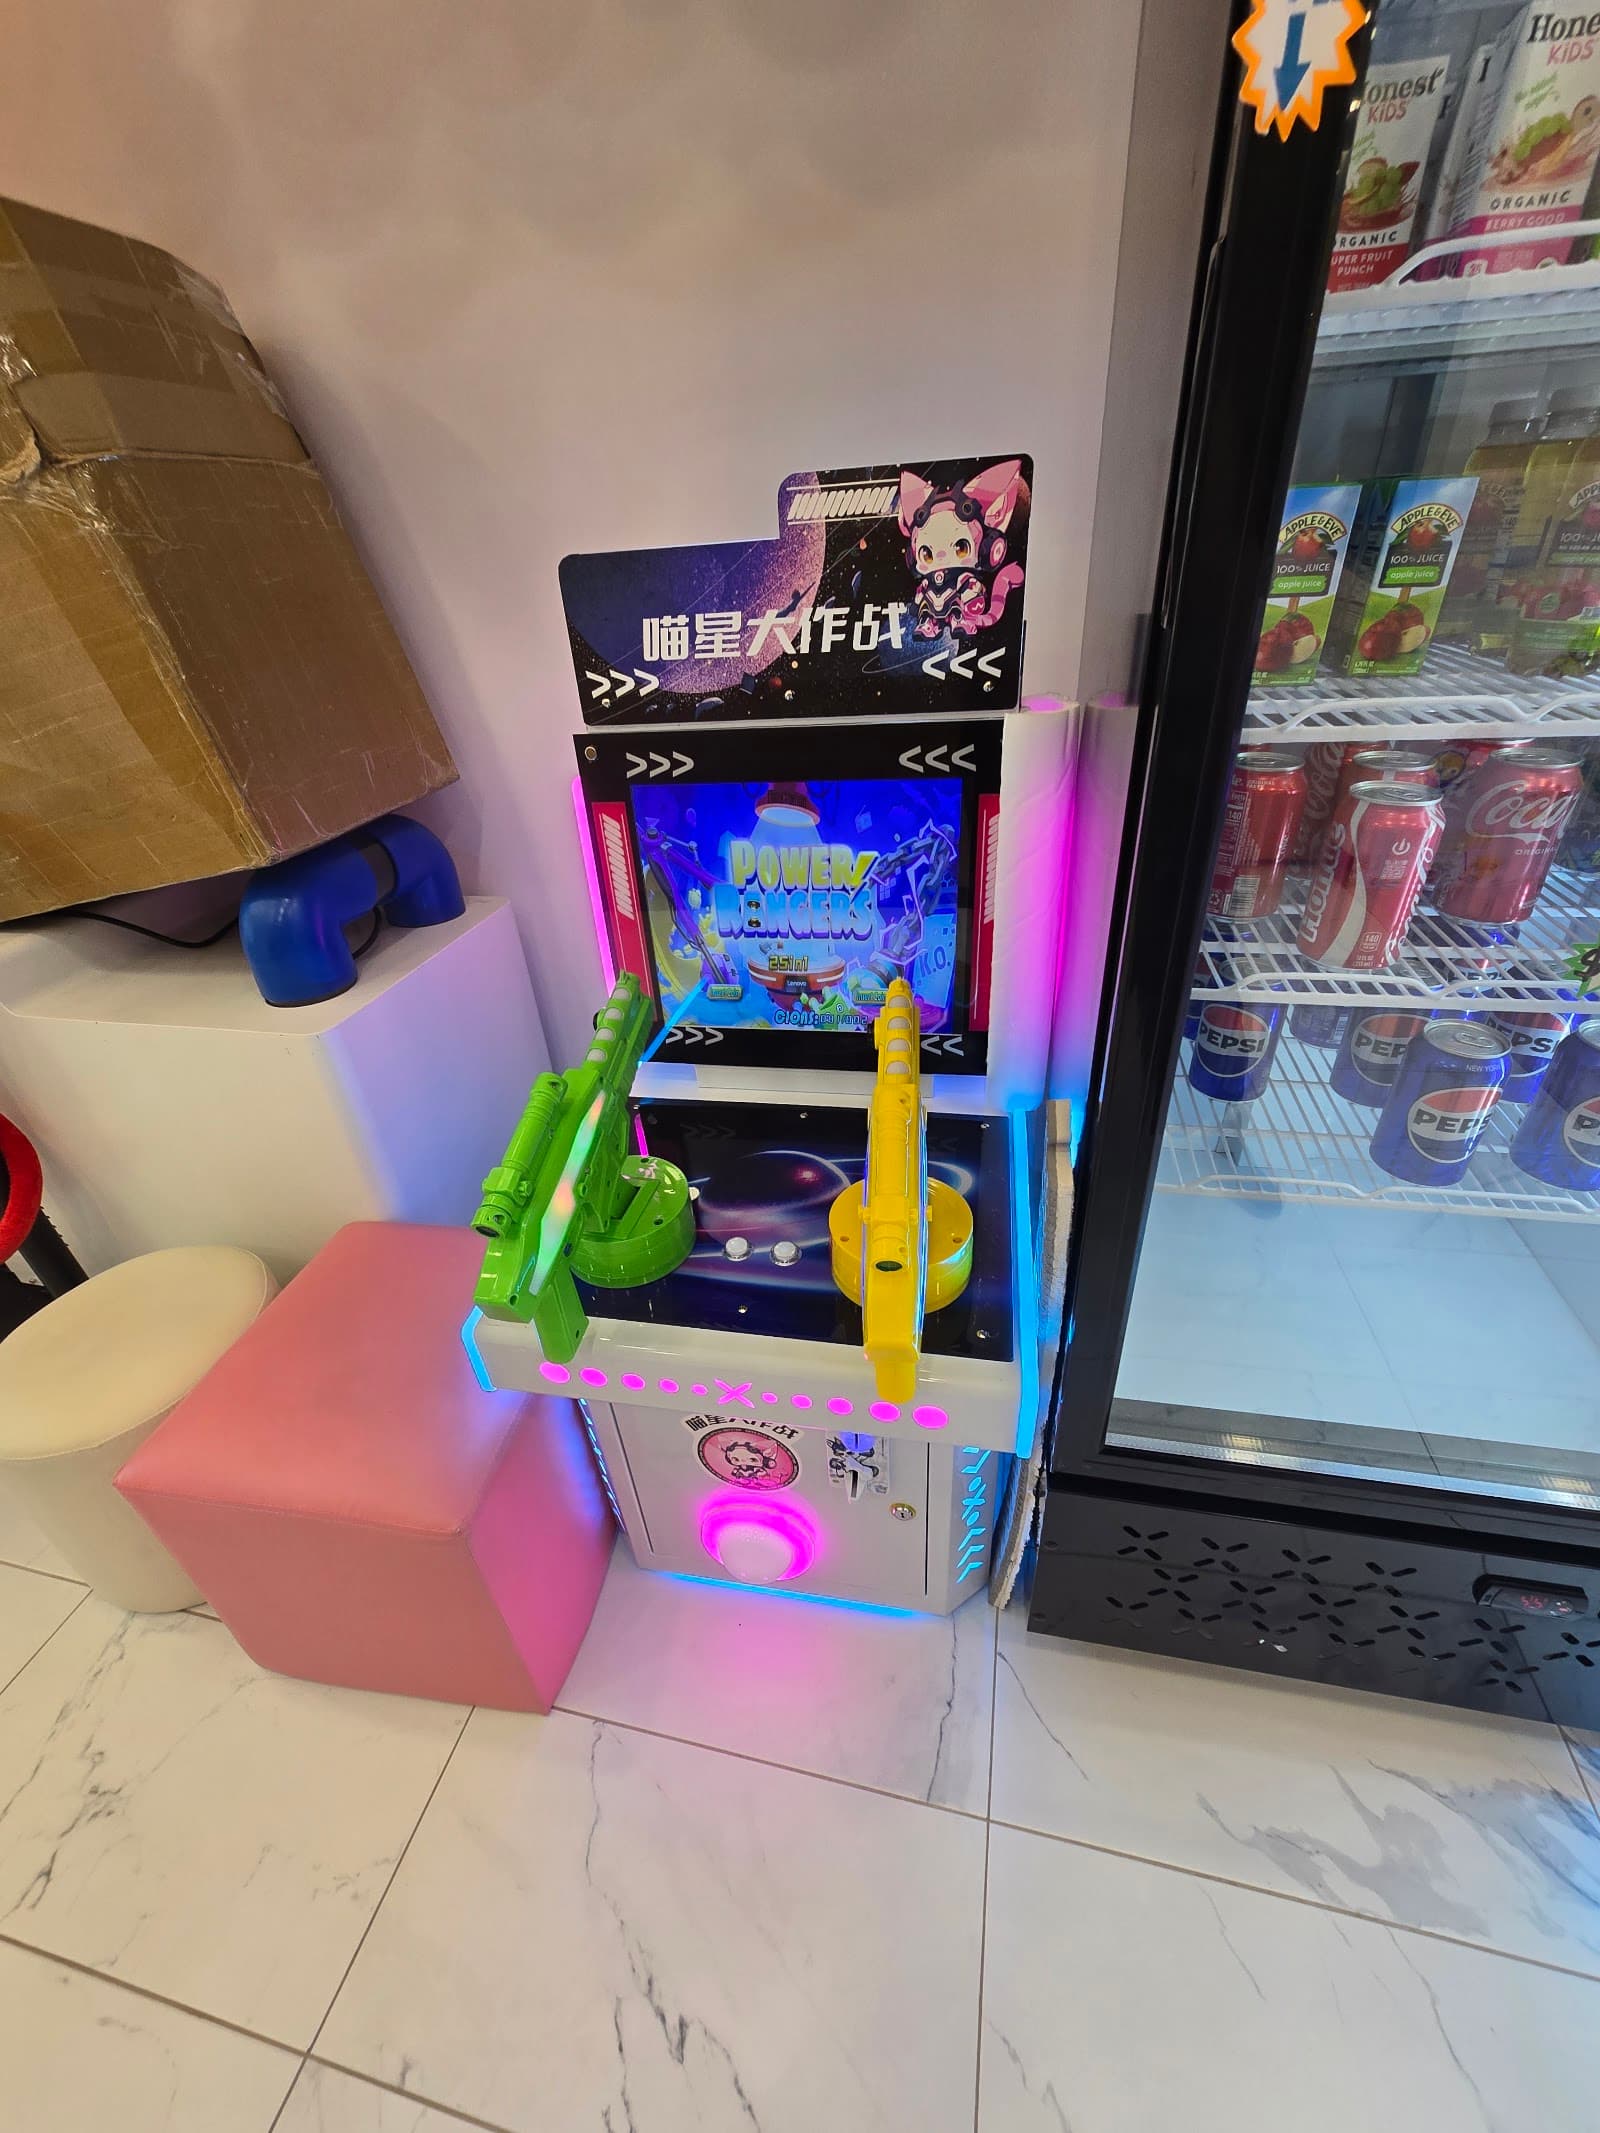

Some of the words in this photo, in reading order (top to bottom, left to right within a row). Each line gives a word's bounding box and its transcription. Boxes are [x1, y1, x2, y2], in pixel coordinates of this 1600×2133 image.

[1361, 64, 1444, 106] onest
[1489, 190, 1571, 210] ORGANIC
[1484, 216, 1522, 232] BERRY
[1525, 212, 1566, 227] GOOD
[1330, 254, 1358, 266] UPER
[1360, 249, 1394, 263] FRUIT
[1337, 264, 1375, 277] PUNCH
[1416, 553, 1447, 564] JUICE
[1303, 562, 1332, 573] JUICE
[1391, 571, 1414, 580] apple
[1414, 569, 1435, 580] juice
[1277, 581, 1301, 590] apple
[1301, 579, 1322, 589] juice
[642, 601, 908, 662] 喵星大作战
[730, 840, 857, 891] POWER
[1199, 1021, 1266, 1053] PEPSI
[1464, 1064, 1484, 1073] NEW
